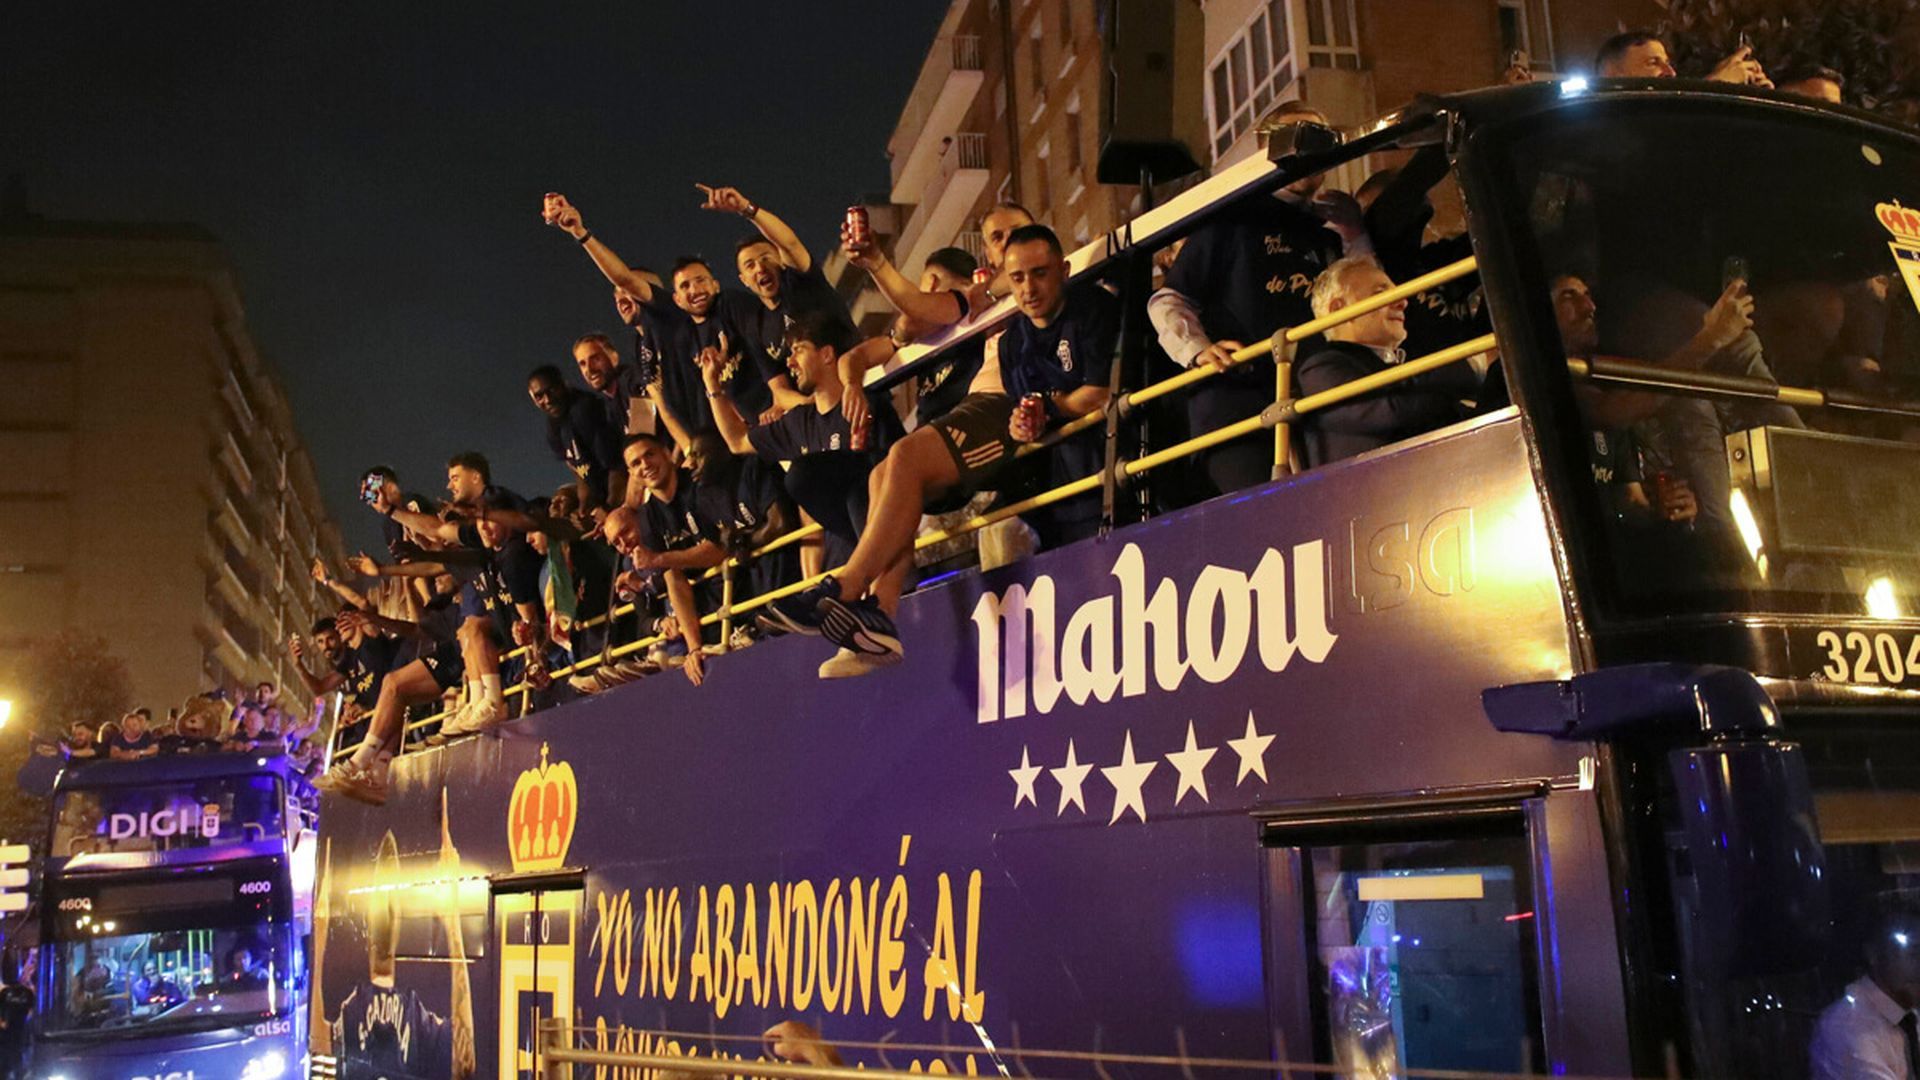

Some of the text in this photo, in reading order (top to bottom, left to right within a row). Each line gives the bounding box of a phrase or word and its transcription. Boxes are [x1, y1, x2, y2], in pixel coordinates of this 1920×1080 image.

[970, 539, 1339, 724] Mahou
[110, 809, 188, 839] DIGI
[239, 880, 271, 894] 4600
[58, 897, 91, 911] 4600
[593, 834, 985, 1023] YO NO ABANDONÉ AL
[254, 1019, 291, 1037] alsa
